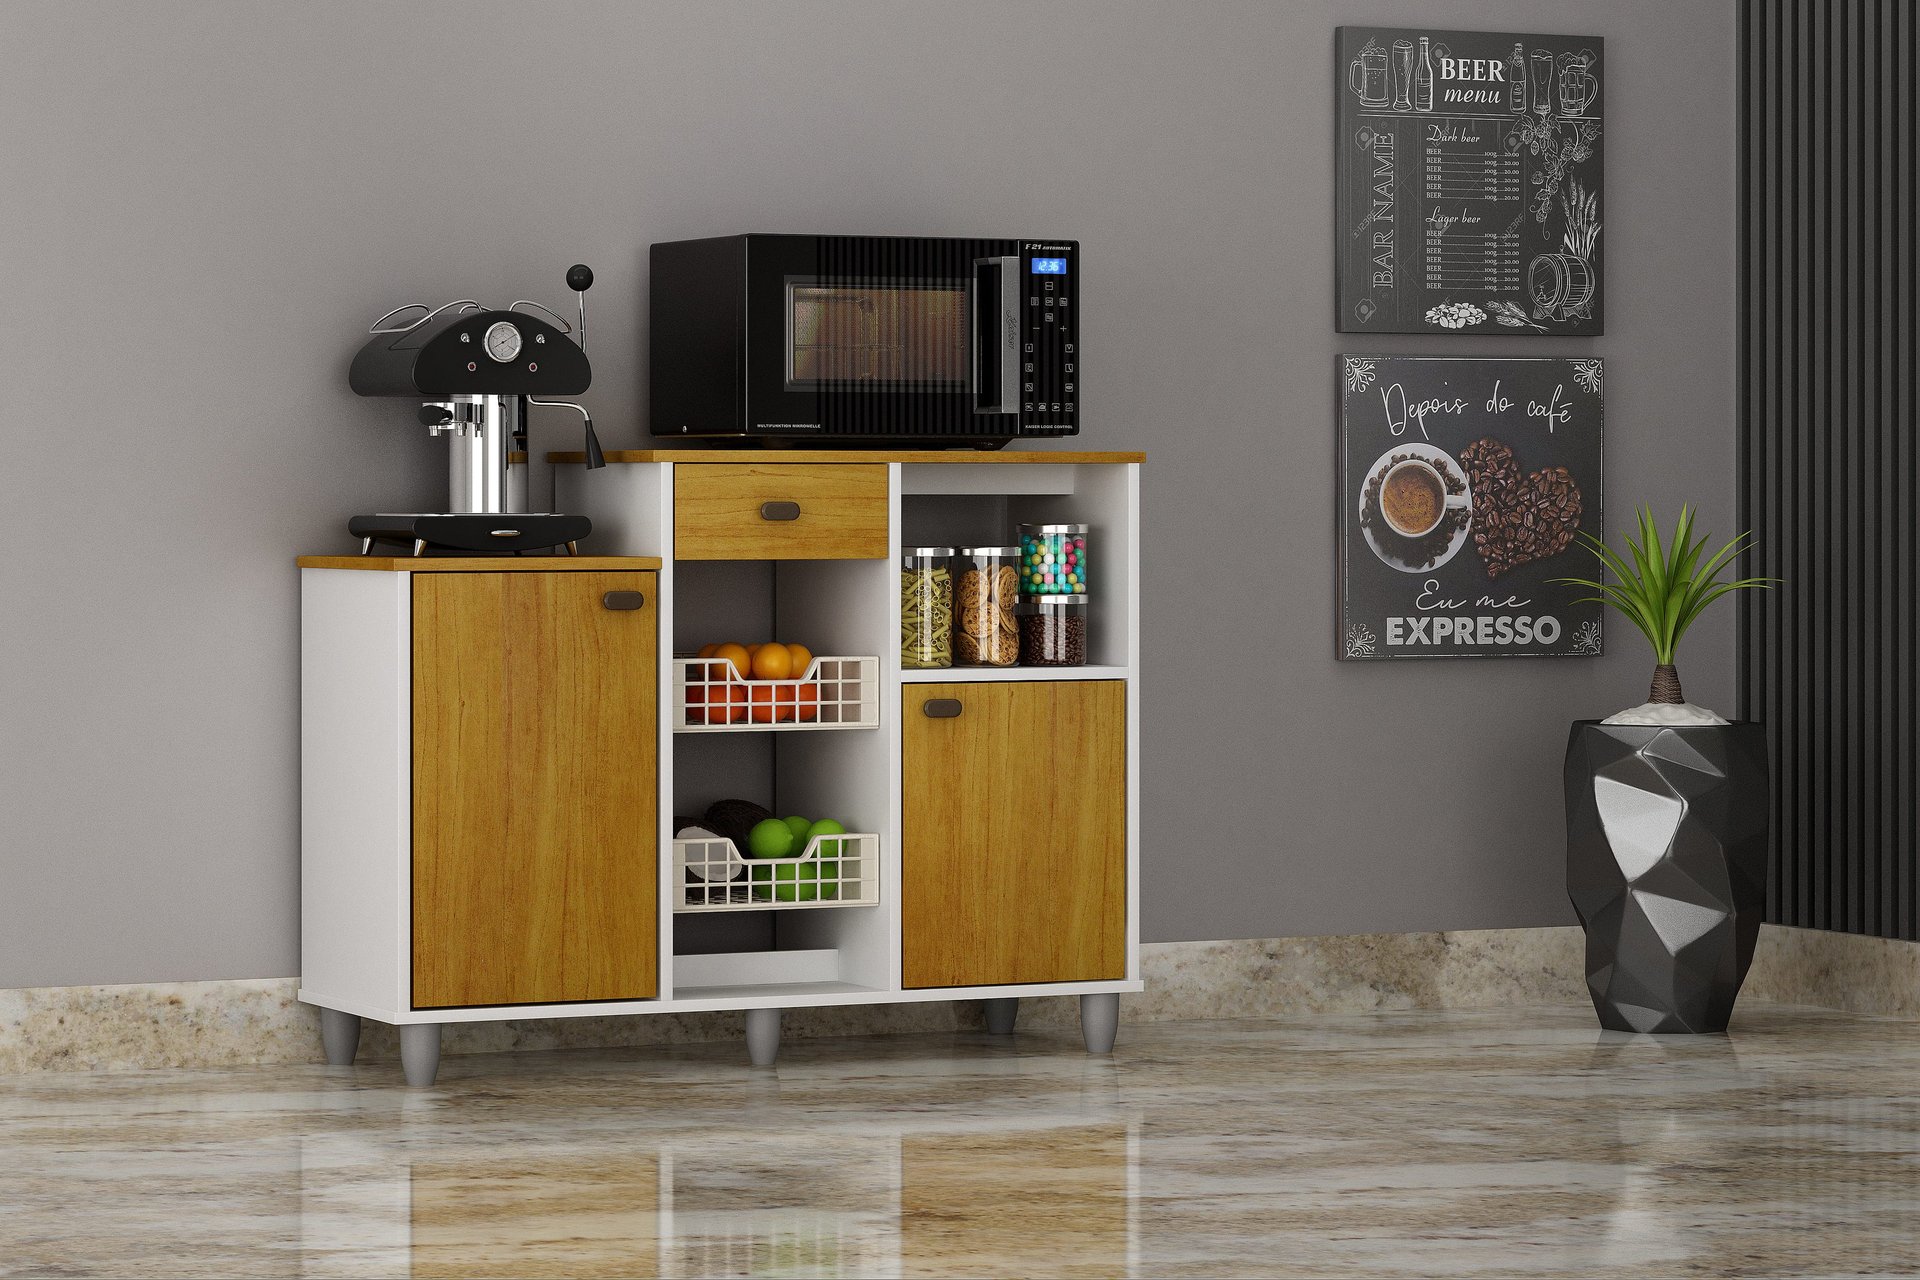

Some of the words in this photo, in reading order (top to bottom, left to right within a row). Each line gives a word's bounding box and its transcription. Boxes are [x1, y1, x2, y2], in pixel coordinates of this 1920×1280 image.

[1440, 58, 1505, 82] BEER
[1444, 88, 1501, 104] menu
[1426, 124, 1457, 142] Dark
[1461, 127, 1480, 142] beer
[1373, 132, 1394, 222] NAME
[1425, 206, 1458, 228] Lager
[1462, 208, 1480, 223] beer
[1373, 229, 1394, 288] BAR
[1380, 382, 1468, 440] Depois
[1486, 380, 1514, 414] do
[1527, 384, 1572, 433] café
[1416, 579, 1466, 610] Eu
[1476, 596, 1531, 608] me
[1386, 616, 1561, 646] EXPRESSO
